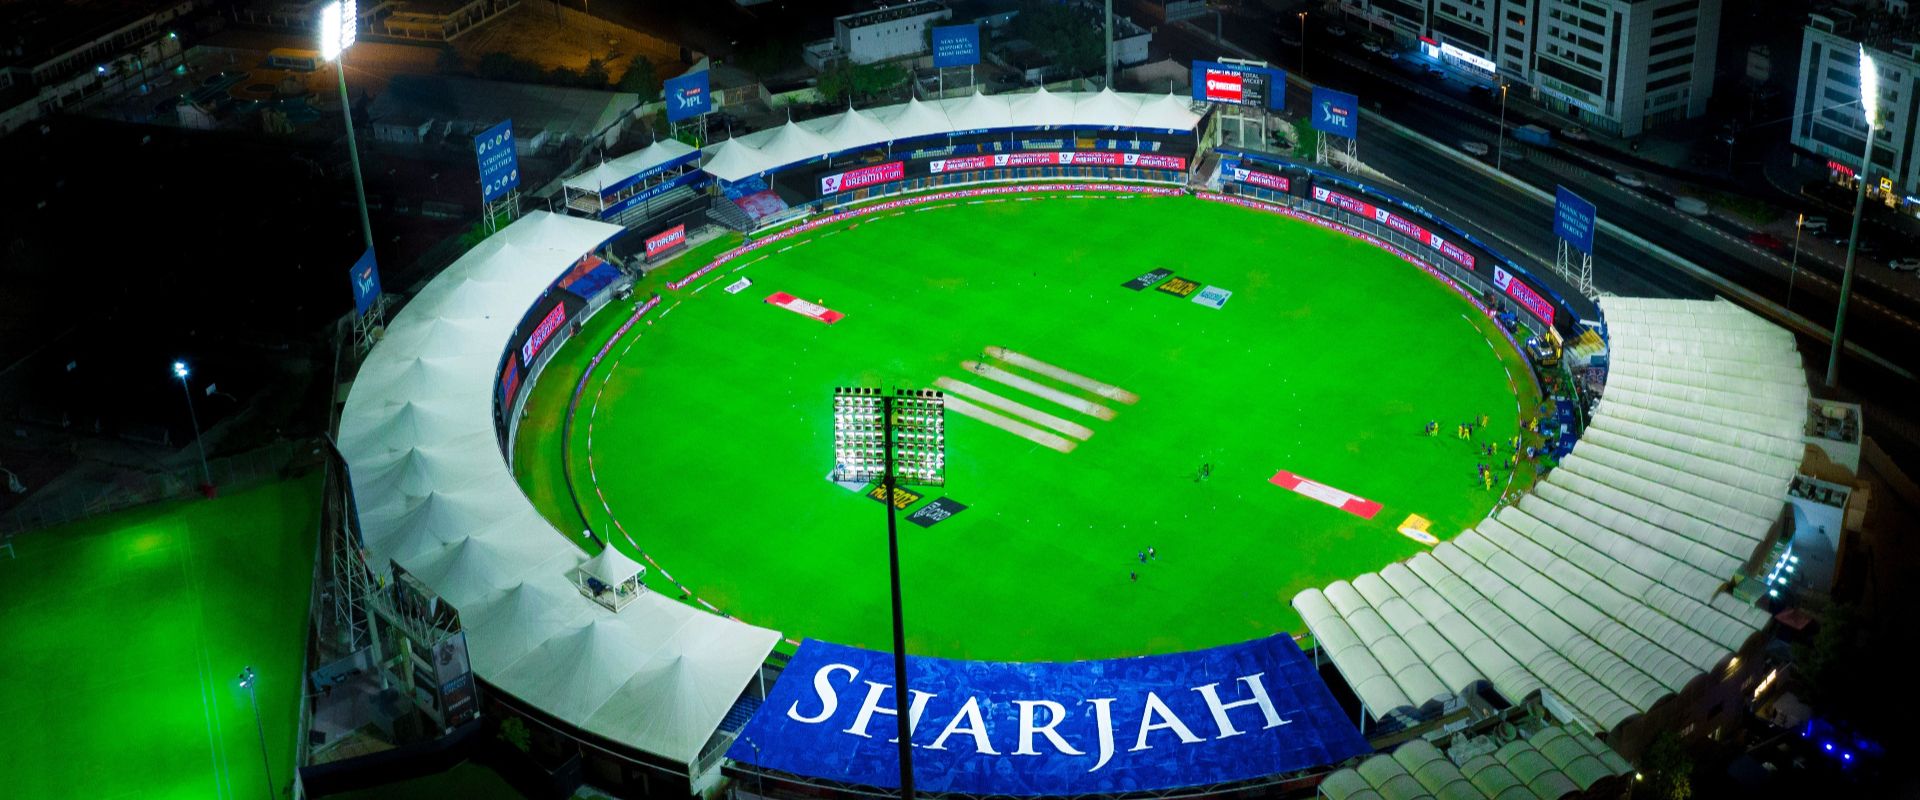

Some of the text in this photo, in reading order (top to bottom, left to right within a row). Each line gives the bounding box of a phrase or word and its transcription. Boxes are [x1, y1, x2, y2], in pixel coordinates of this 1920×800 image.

[686, 95, 702, 108] IPL
[1332, 114, 1347, 128] IPL
[482, 146, 511, 168] STRONGER
[484, 156, 512, 176] TOGETHER
[662, 182, 675, 191] 2020
[1559, 201, 1591, 224] THANK YOU
[1559, 210, 1588, 232] FRONTLINE
[1562, 221, 1583, 239] HEROES
[787, 663, 1293, 773] SHARJAH
